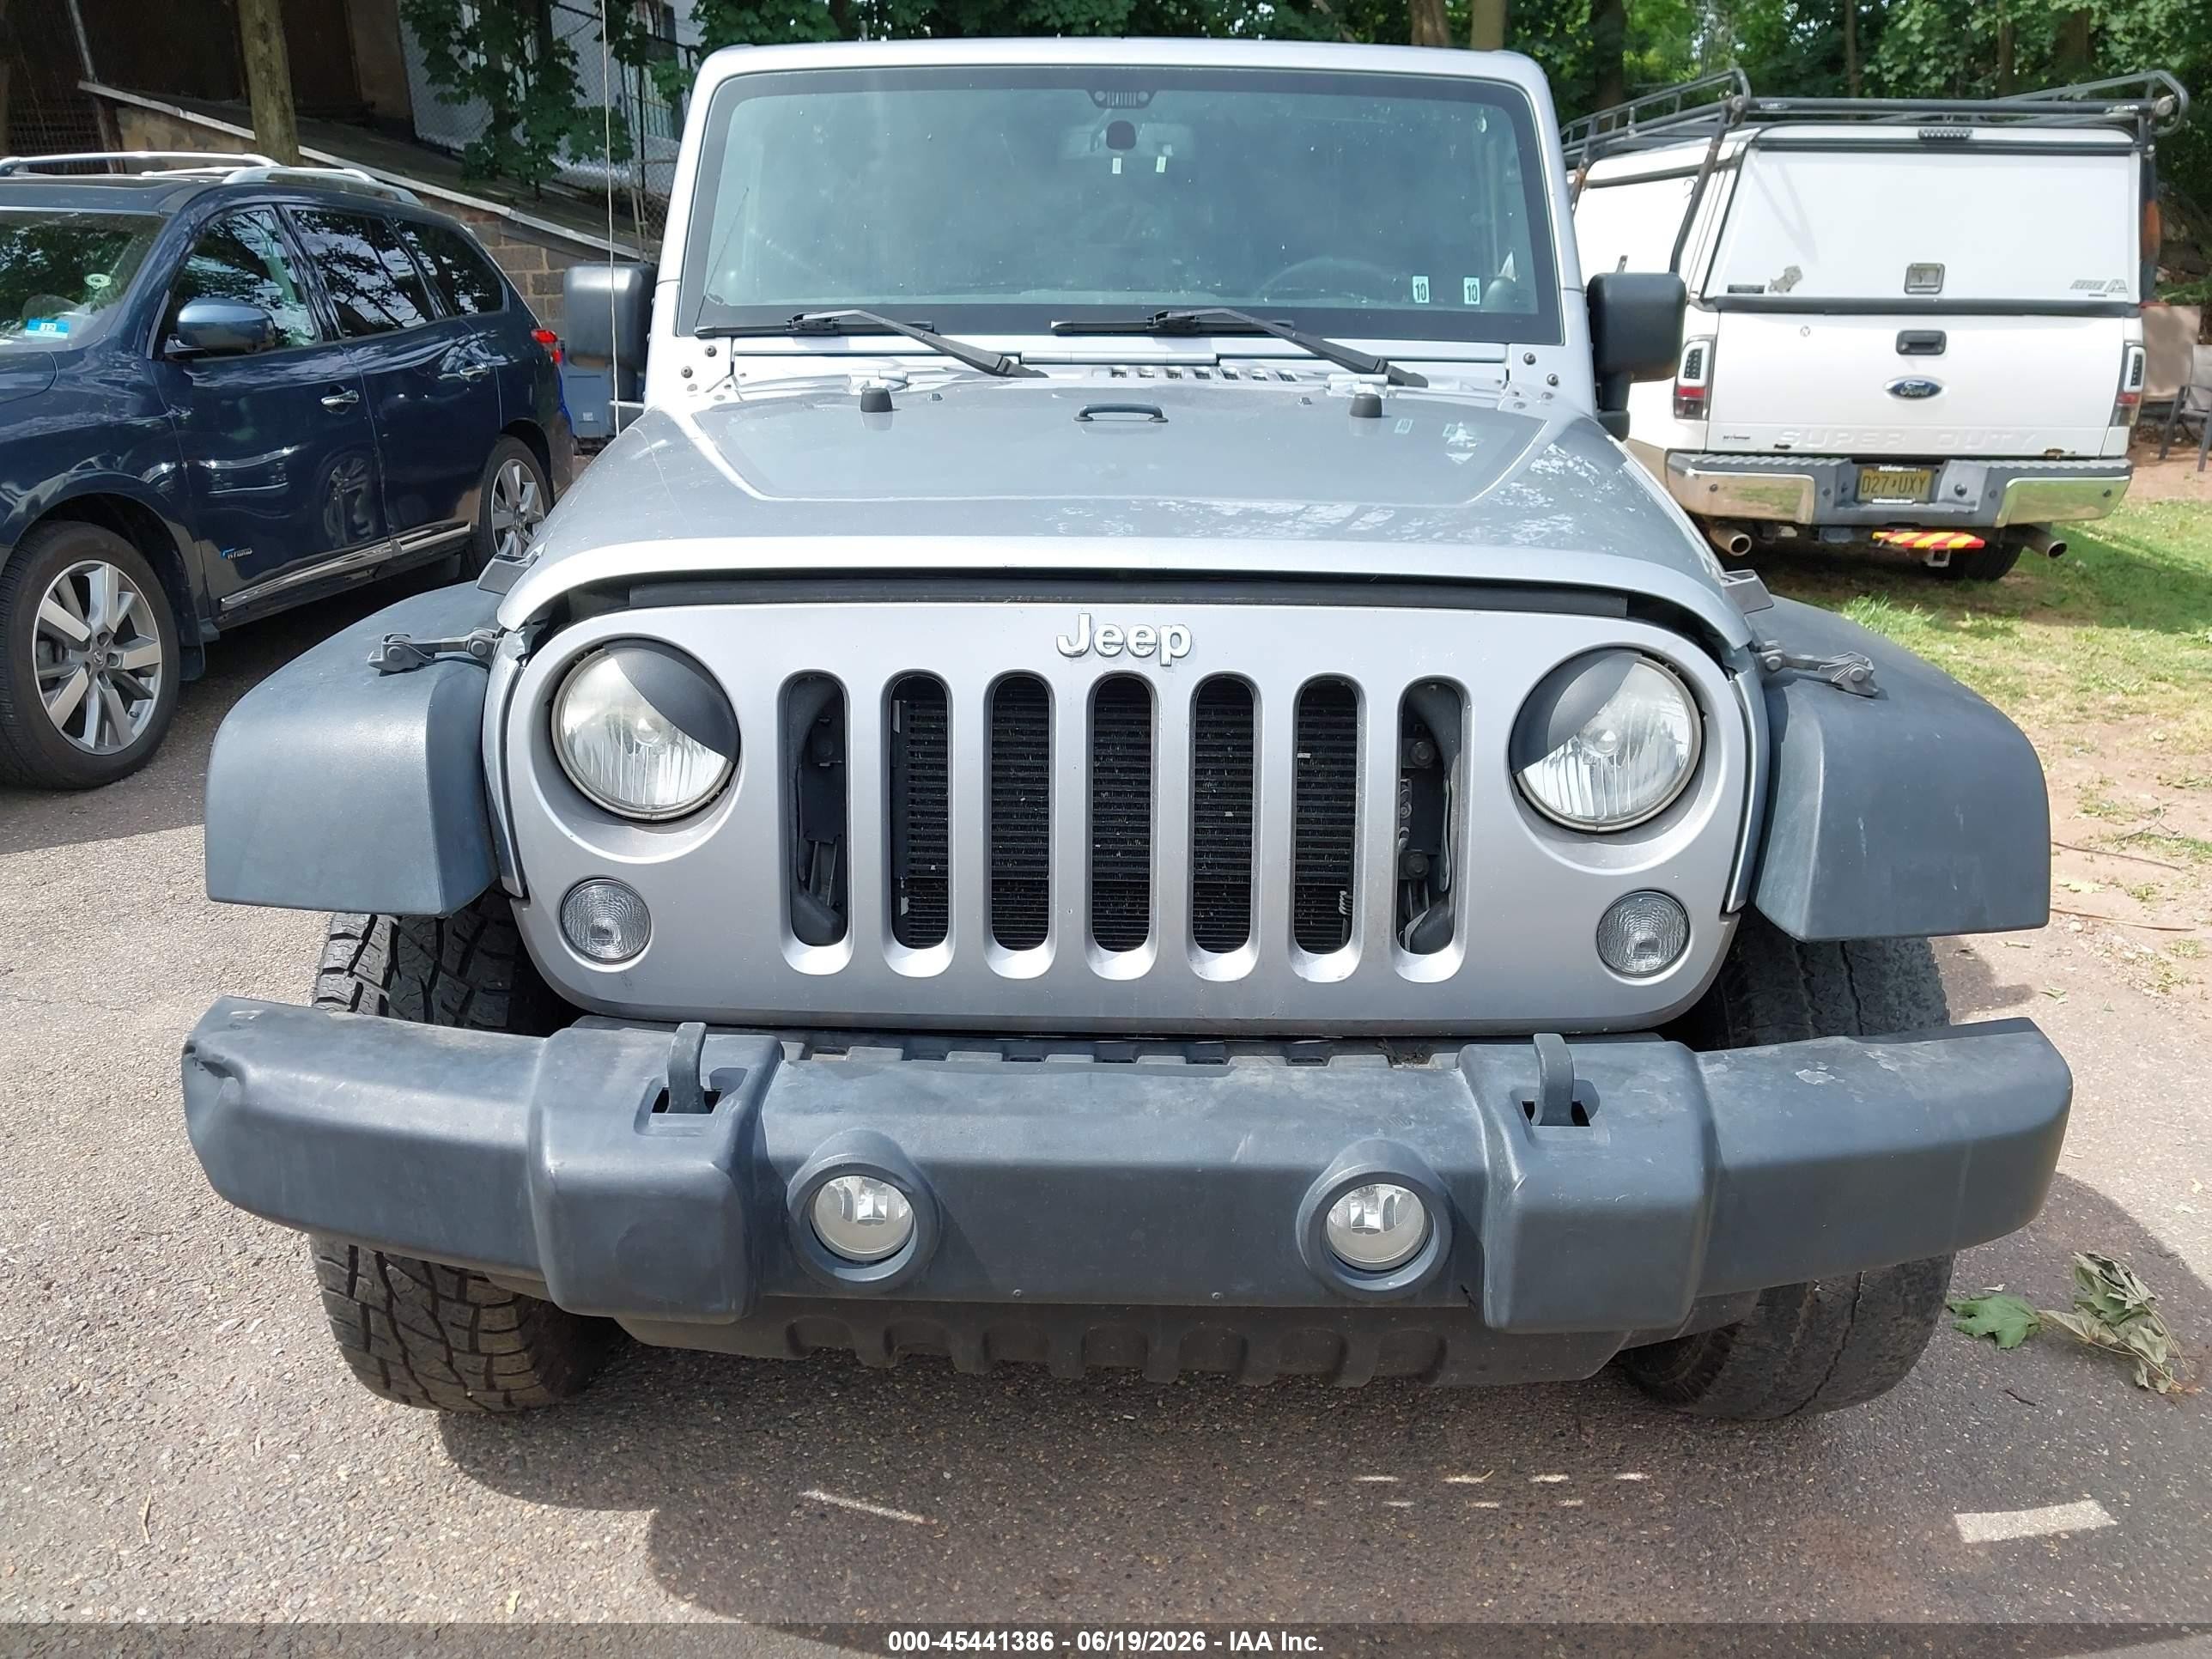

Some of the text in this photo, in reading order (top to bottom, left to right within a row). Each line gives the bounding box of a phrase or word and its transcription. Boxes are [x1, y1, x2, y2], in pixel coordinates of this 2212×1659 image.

[1778, 430, 2038, 450] SUPER DUTY
[1056, 612, 1193, 666] Jeep
